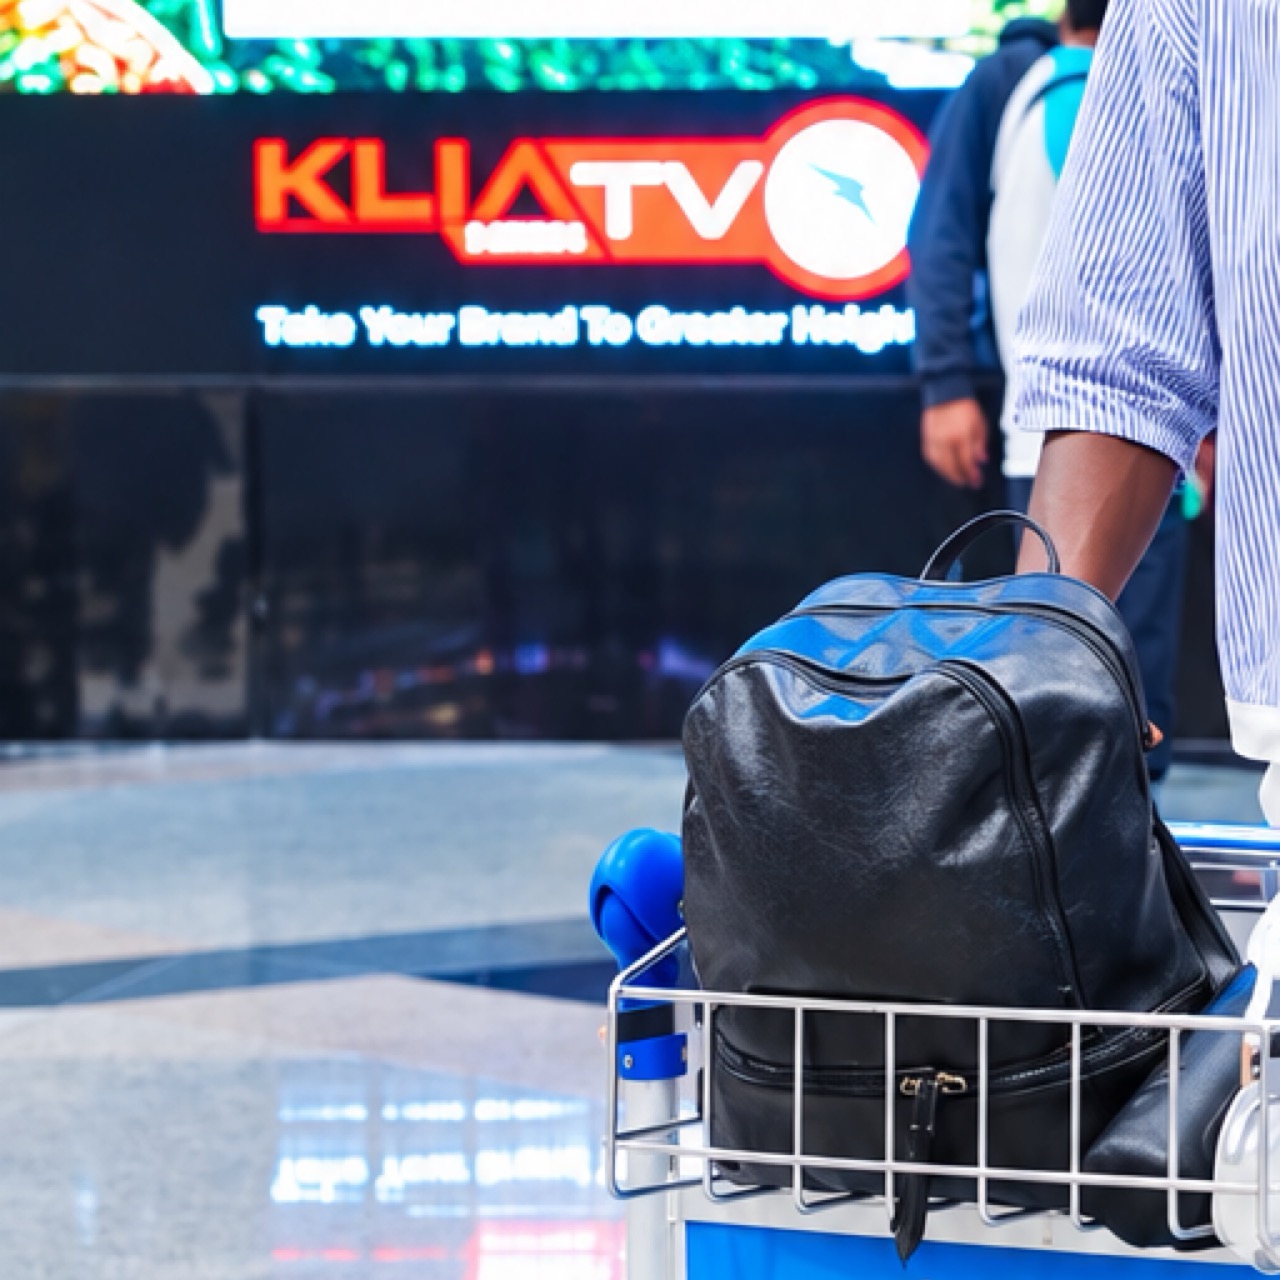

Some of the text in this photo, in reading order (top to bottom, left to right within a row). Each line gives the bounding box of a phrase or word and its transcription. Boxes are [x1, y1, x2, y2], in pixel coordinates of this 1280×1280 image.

[256, 305, 356, 347] Take
[359, 305, 456, 347] Your
[458, 305, 579, 347] Brand
[580, 305, 633, 347] To
[635, 305, 790, 347] Greater
